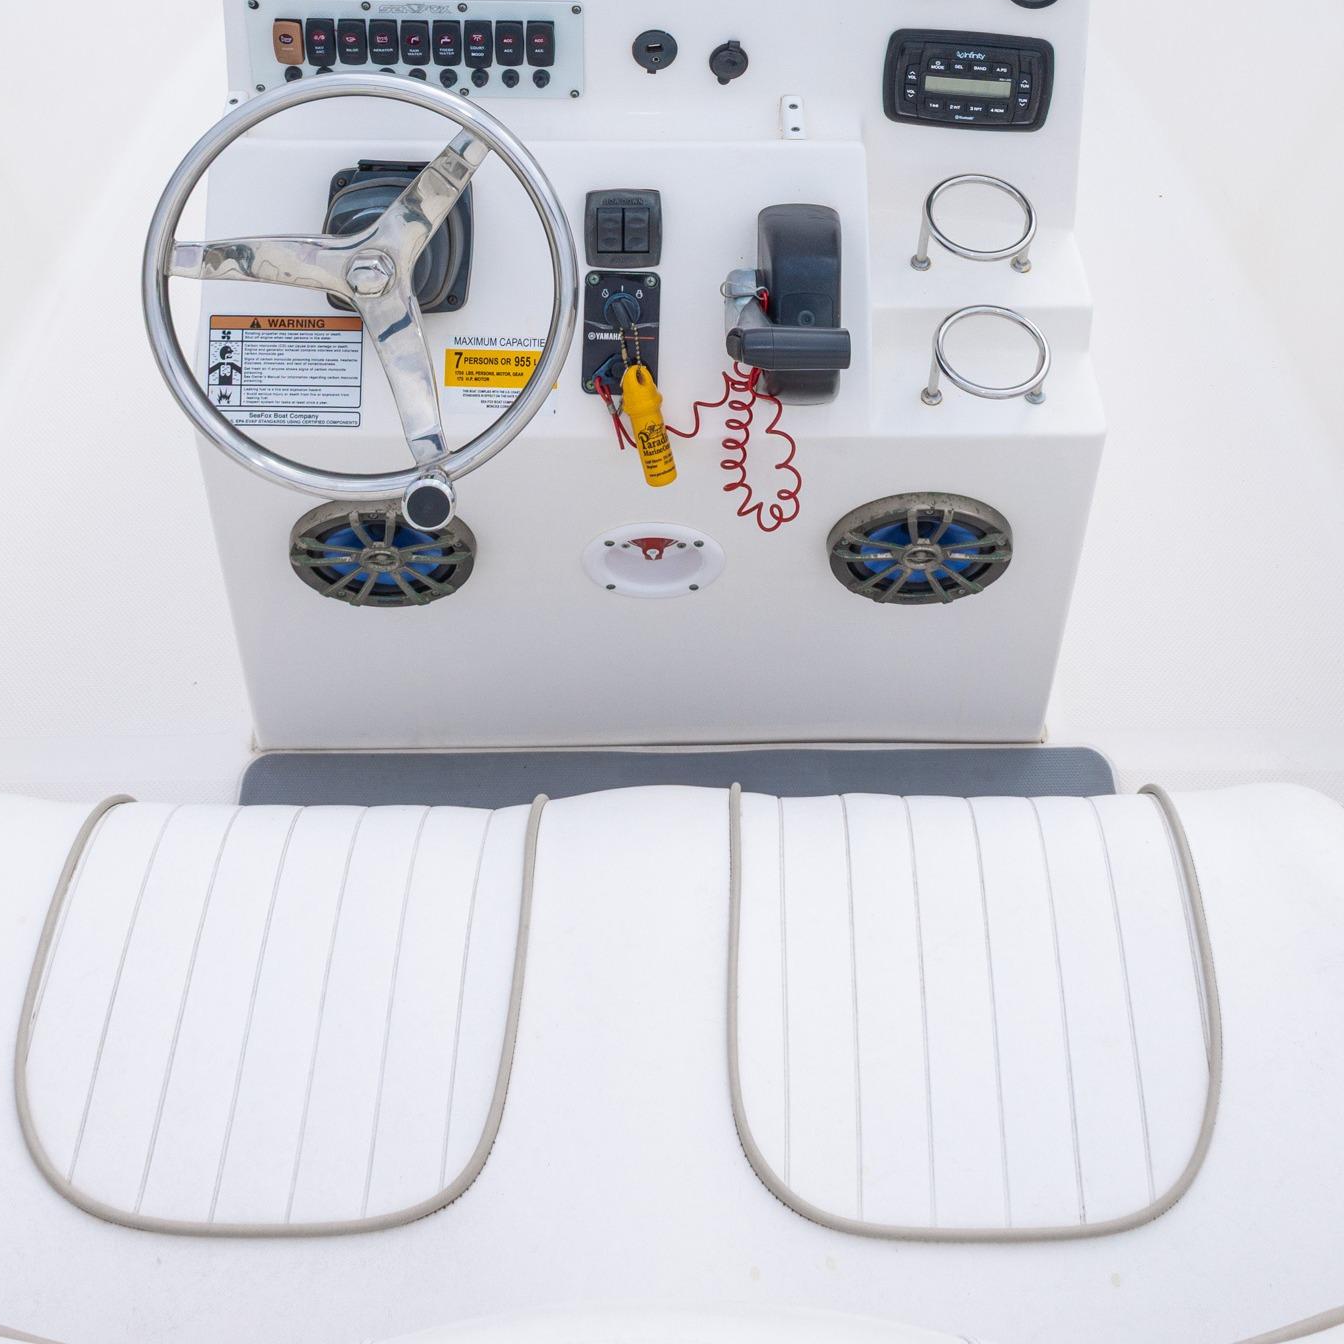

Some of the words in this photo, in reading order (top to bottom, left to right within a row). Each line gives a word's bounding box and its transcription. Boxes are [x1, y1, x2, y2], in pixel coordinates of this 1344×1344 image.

[268, 319, 325, 328] WARNING
[596, 332, 622, 341] YAMAHA
[454, 337, 496, 346] MAXIMUM
[499, 338, 545, 347] CAPACITIE
[454, 352, 463, 369] 7
[464, 357, 499, 365] PERSONS
[514, 356, 531, 367] 955
